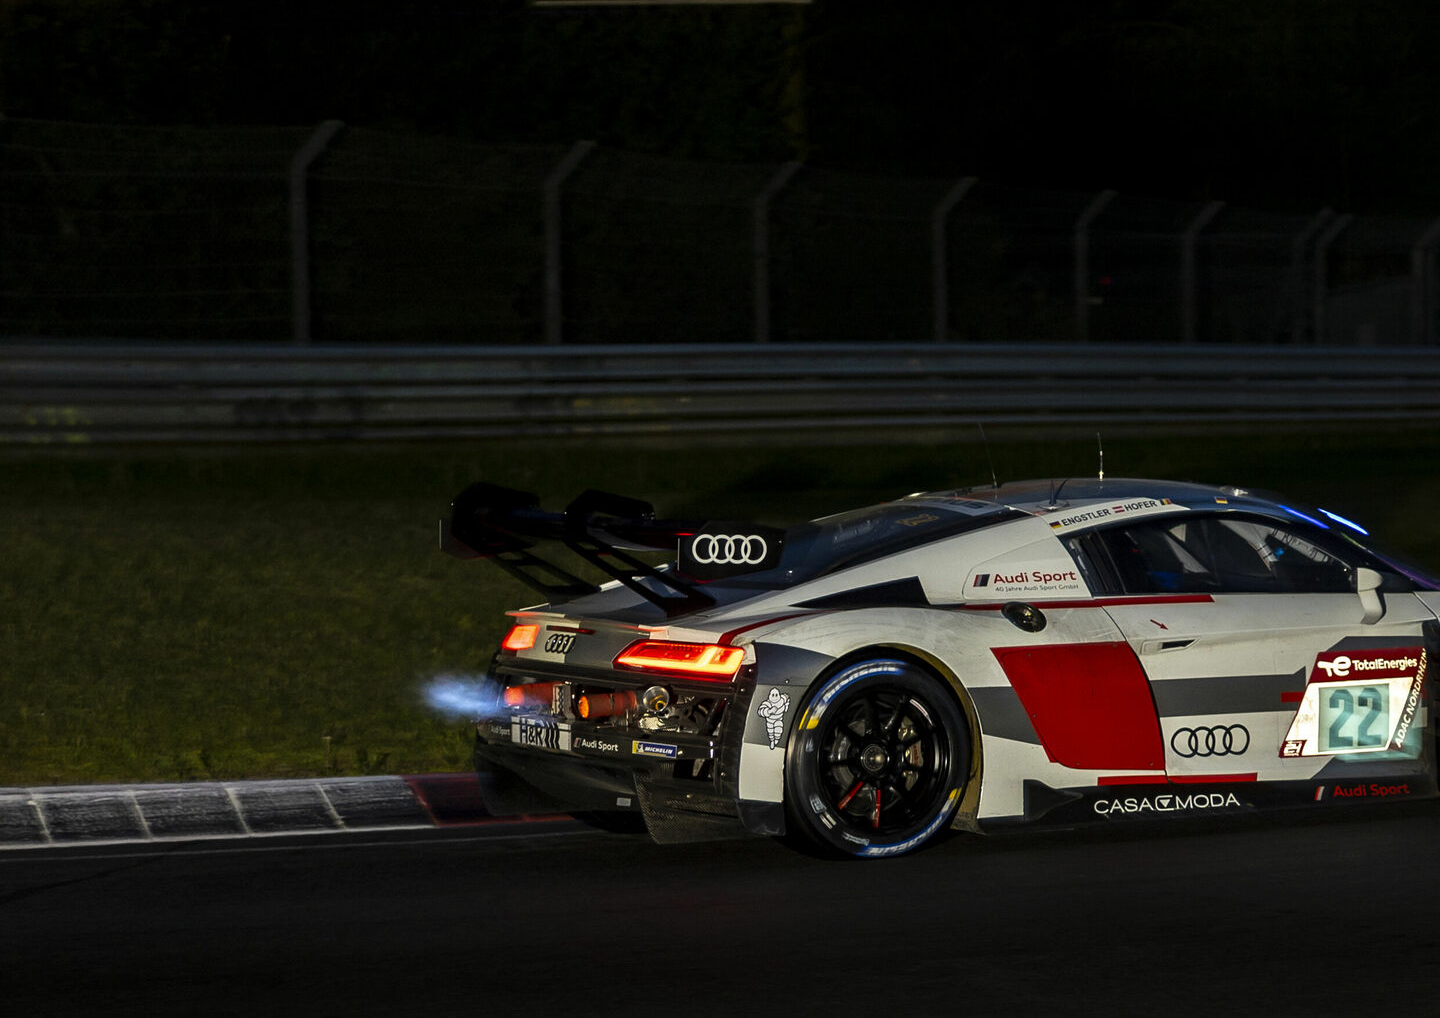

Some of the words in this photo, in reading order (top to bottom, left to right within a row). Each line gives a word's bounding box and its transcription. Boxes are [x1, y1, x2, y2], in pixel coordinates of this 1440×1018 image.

[1061, 508, 1111, 525] ENGSTLER
[1124, 500, 1158, 512] HOFER
[994, 572, 1029, 584] Audi
[1032, 571, 1076, 584] Sport
[1039, 584, 1057, 592] Sport
[1352, 656, 1418, 671] TotalEnergies
[1328, 687, 1382, 748] 22
[520, 717, 543, 746] H&R
[1394, 713, 1411, 748] ADAC
[581, 737, 597, 749] Audi
[597, 740, 619, 753] Sport
[644, 746, 673, 755] MICHELIN
[1334, 784, 1367, 798] Audi
[1369, 783, 1411, 798] Sport
[1093, 797, 1155, 814] CASA
[1175, 792, 1241, 810] MODA
